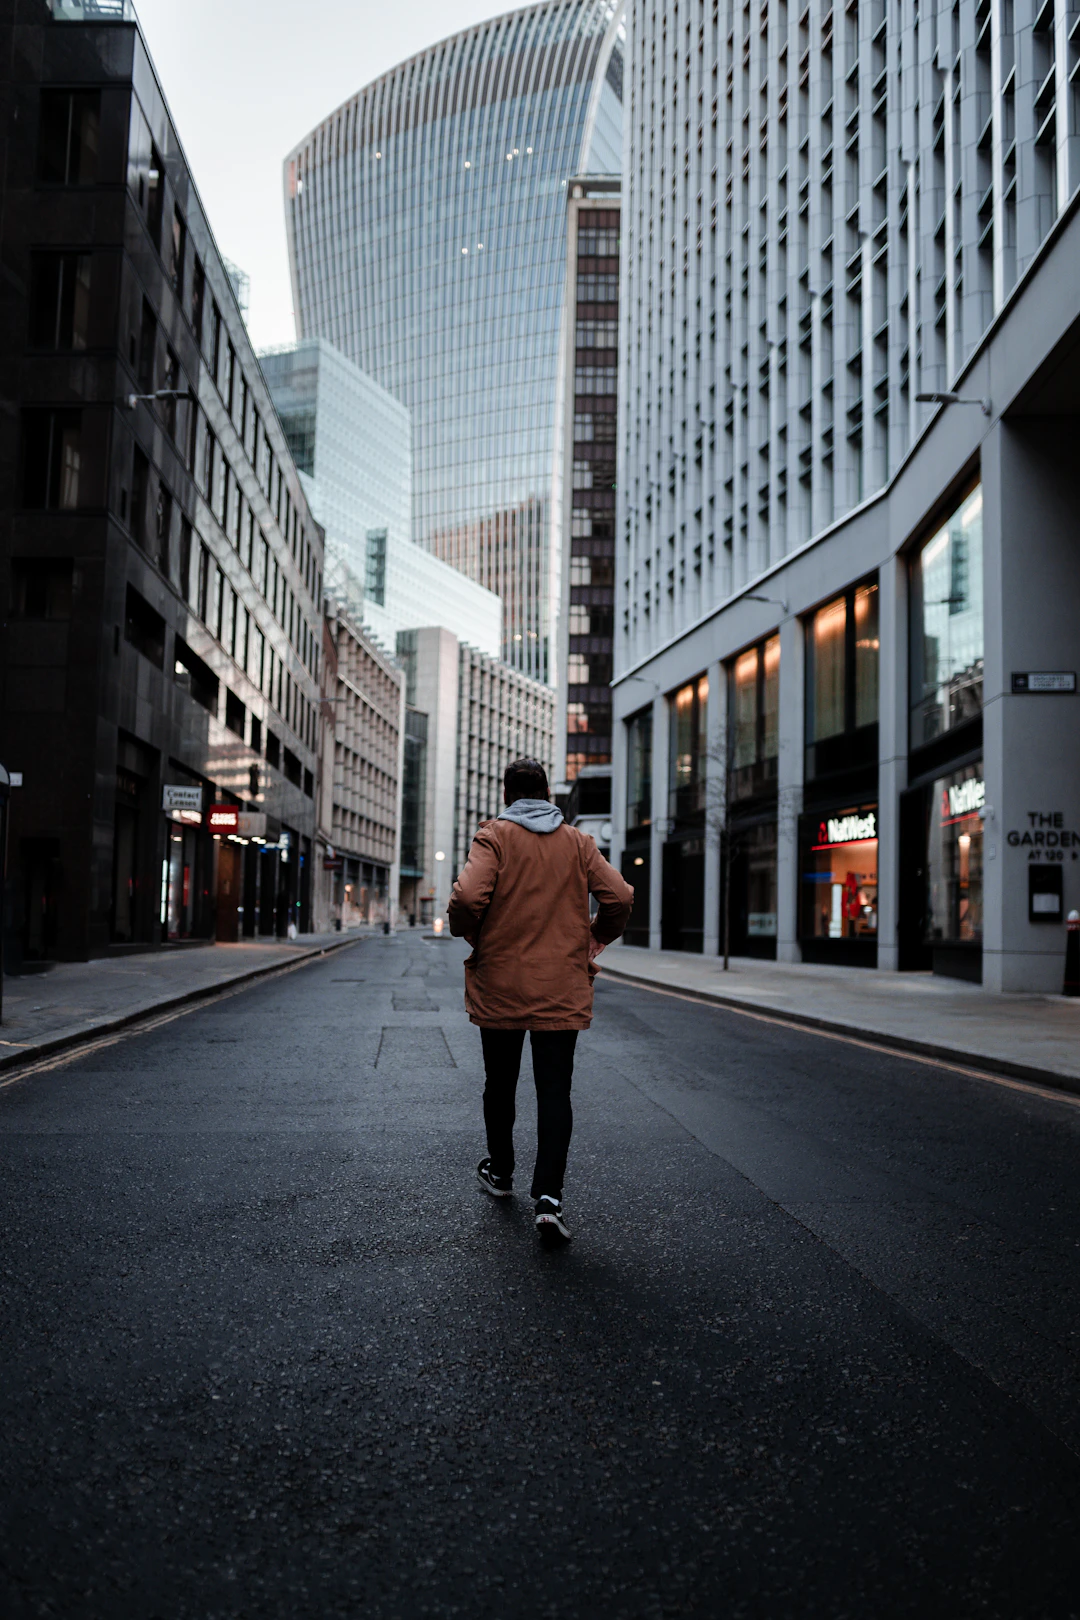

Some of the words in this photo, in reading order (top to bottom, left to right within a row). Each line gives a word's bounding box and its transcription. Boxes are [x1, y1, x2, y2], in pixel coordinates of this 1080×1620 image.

[167, 789, 199, 799] Contact
[169, 797, 197, 806] Lenses
[949, 778, 986, 815] NatWes
[827, 812, 876, 843] NatWest
[1027, 811, 1064, 829] THE
[1007, 830, 1080, 847] GARDEN
[1028, 850, 1041, 860] AT
[1045, 850, 1064, 861] 120
